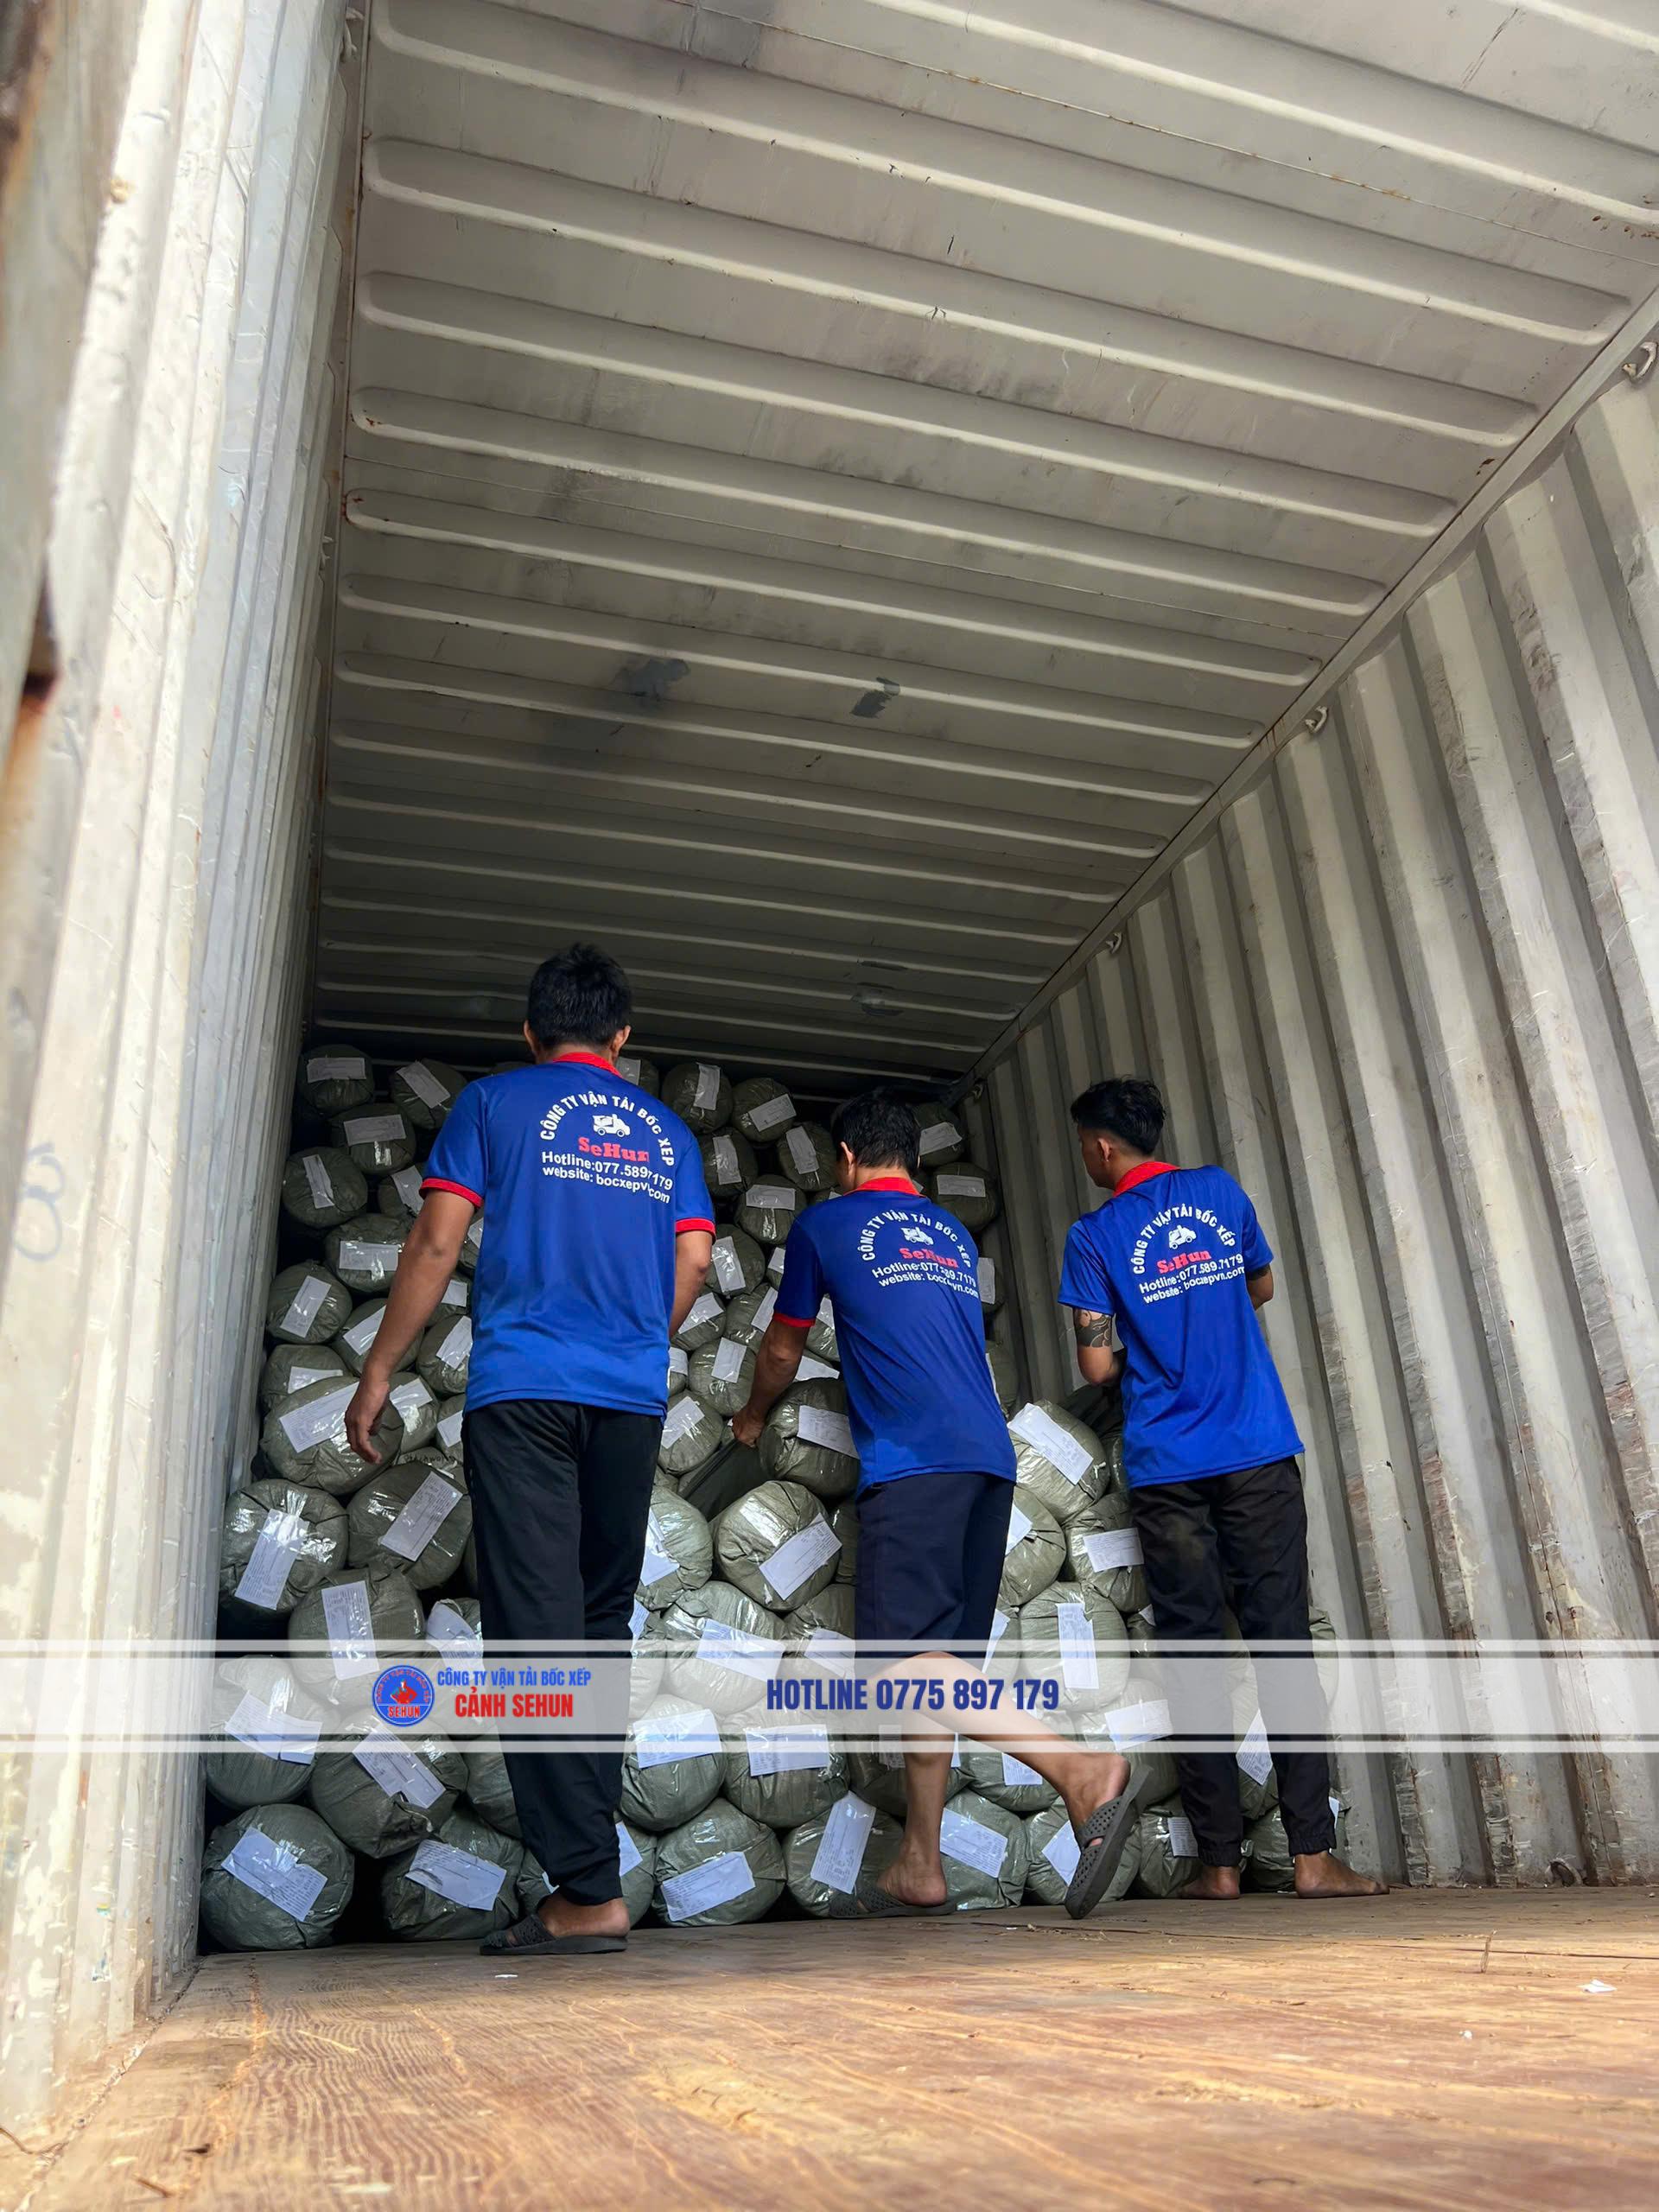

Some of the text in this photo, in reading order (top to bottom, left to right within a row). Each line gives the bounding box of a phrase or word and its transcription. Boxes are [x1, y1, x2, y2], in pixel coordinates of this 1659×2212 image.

[540, 1104, 567, 1141] CÔNG
[560, 1095, 579, 1110] TY
[578, 1090, 607, 1108] VẬN
[612, 1096, 635, 1112] TẢI
[543, 1166, 594, 1183] website:
[857, 1229, 876, 1262] CÔNG
[867, 1216, 886, 1230] TY
[1130, 1239, 1148, 1274] CÔNG
[1141, 1224, 1156, 1240] TY
[1172, 1203, 1193, 1218] TẢI
[879, 1272, 925, 1287] website:
